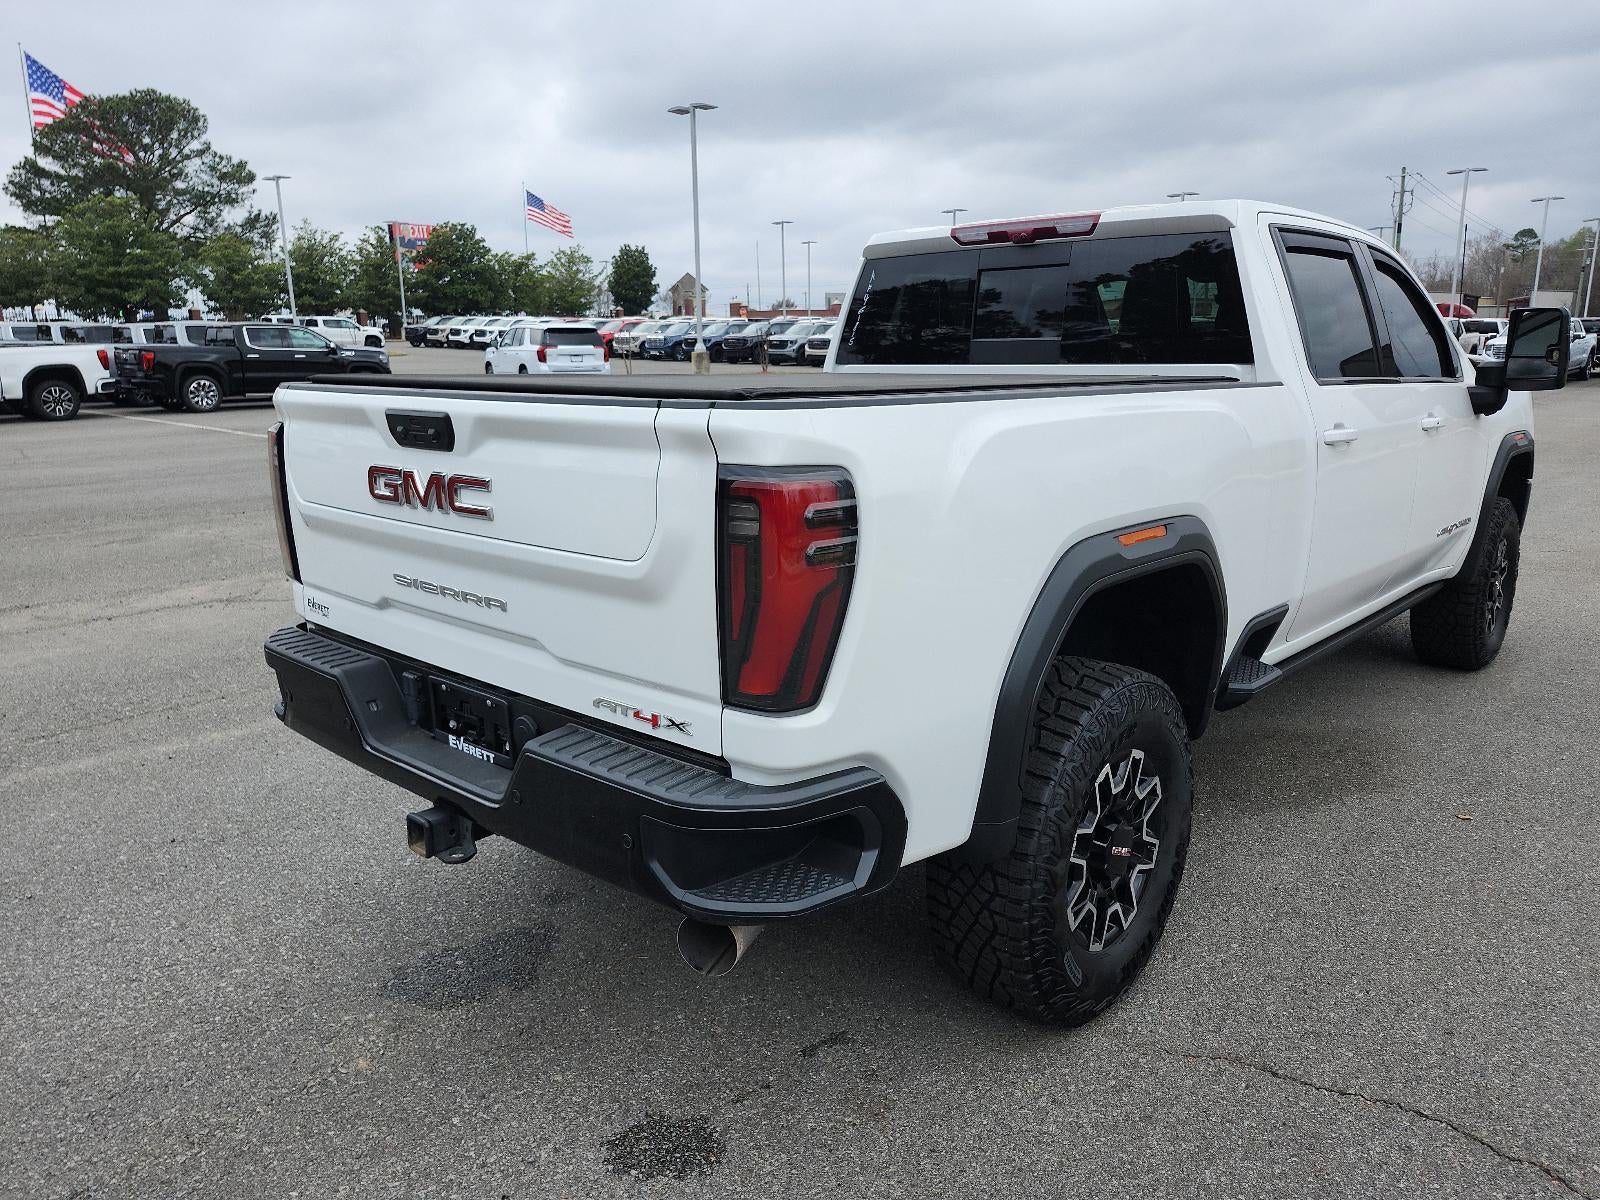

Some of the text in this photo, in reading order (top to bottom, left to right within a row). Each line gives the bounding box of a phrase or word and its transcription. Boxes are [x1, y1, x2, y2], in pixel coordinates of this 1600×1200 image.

[367, 463, 494, 522] GMC
[392, 573, 508, 613] SIERRA
[592, 696, 694, 736] AT4X
[448, 734, 495, 764] EVERETT
